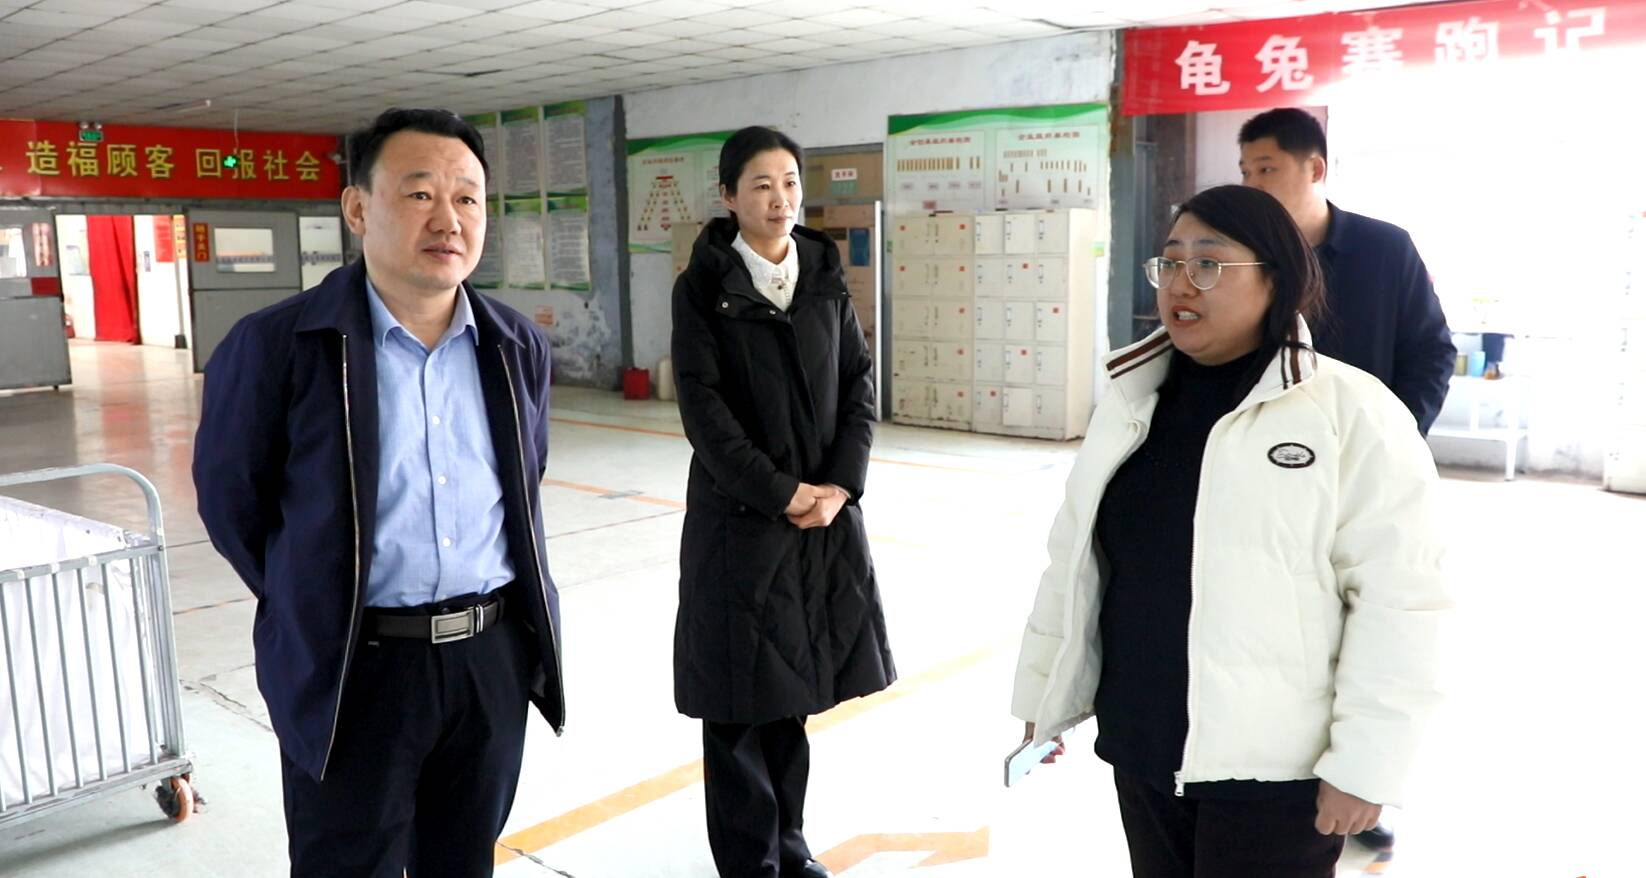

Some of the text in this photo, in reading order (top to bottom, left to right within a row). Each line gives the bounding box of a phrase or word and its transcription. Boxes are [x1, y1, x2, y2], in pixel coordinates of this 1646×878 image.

[26, 140, 320, 181] 造福顾客 回报社会
